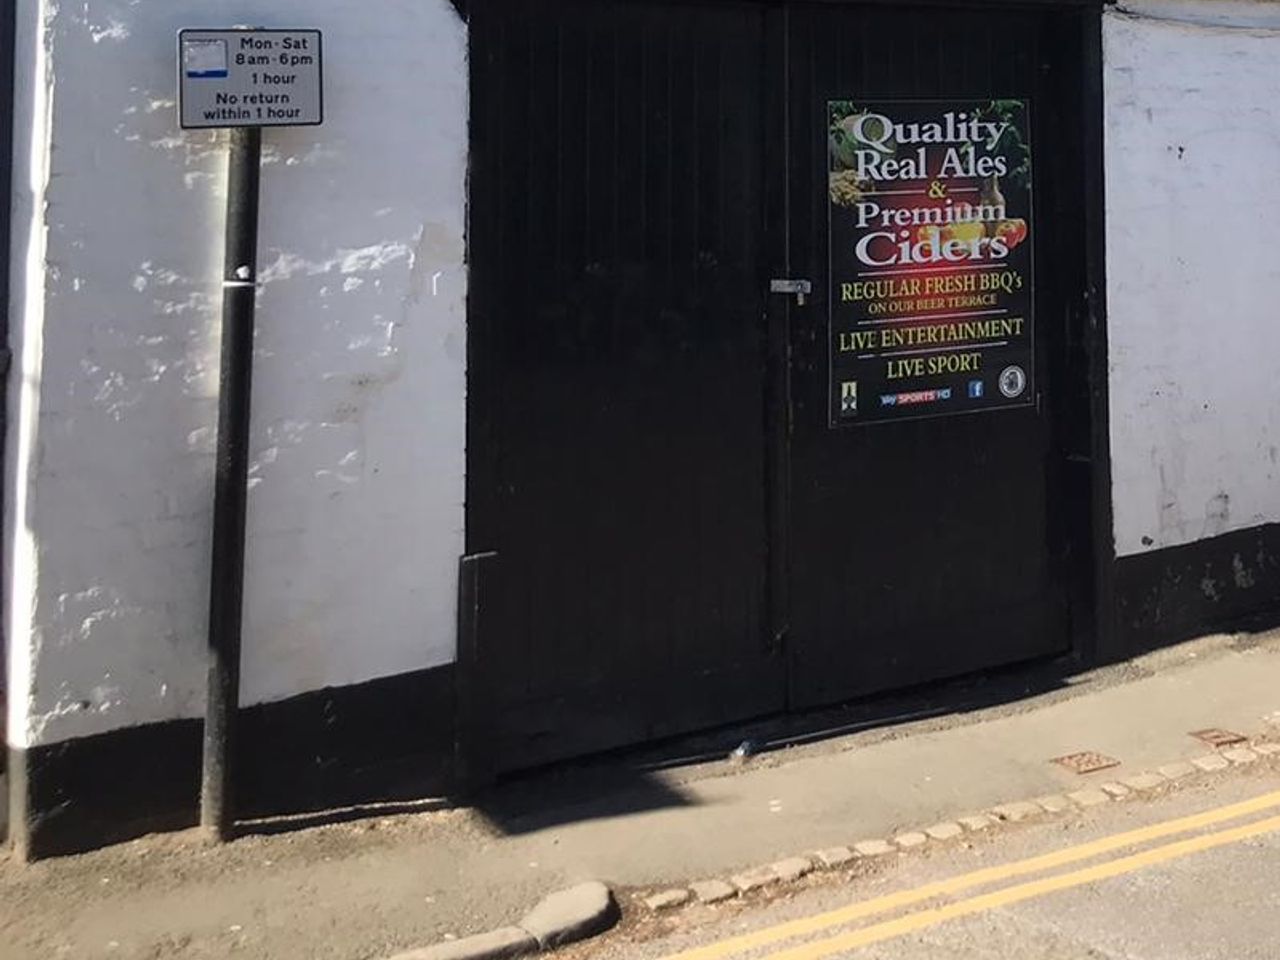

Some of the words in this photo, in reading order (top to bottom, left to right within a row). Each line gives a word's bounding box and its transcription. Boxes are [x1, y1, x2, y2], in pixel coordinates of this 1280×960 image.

[252, 73, 257, 84] 1
[263, 72, 296, 84] hour
[216, 93, 238, 105] No
[243, 93, 290, 104] return
[203, 108, 250, 120] within
[256, 108, 261, 118] 1
[267, 107, 301, 119] hour
[853, 112, 1010, 153] Quality
[855, 147, 927, 181] Real
[937, 147, 1008, 179] Ales
[928, 180, 948, 198] &
[855, 199, 1006, 229] Premium
[855, 227, 1009, 267] Ciders
[841, 279, 921, 301] REGULAR
[924, 274, 976, 295] FRESH
[980, 271, 1022, 293] BBQ's
[868, 302, 887, 315] ON
[889, 299, 915, 313] OUR
[917, 297, 945, 311] BEER
[948, 294, 998, 308] TERRACE
[840, 330, 878, 352] LIVE
[881, 318, 1024, 348] ENTERTAINMENT
[887, 358, 925, 379] LIVE
[928, 352, 982, 375] SPORT
[897, 390, 936, 405] SPORTS
